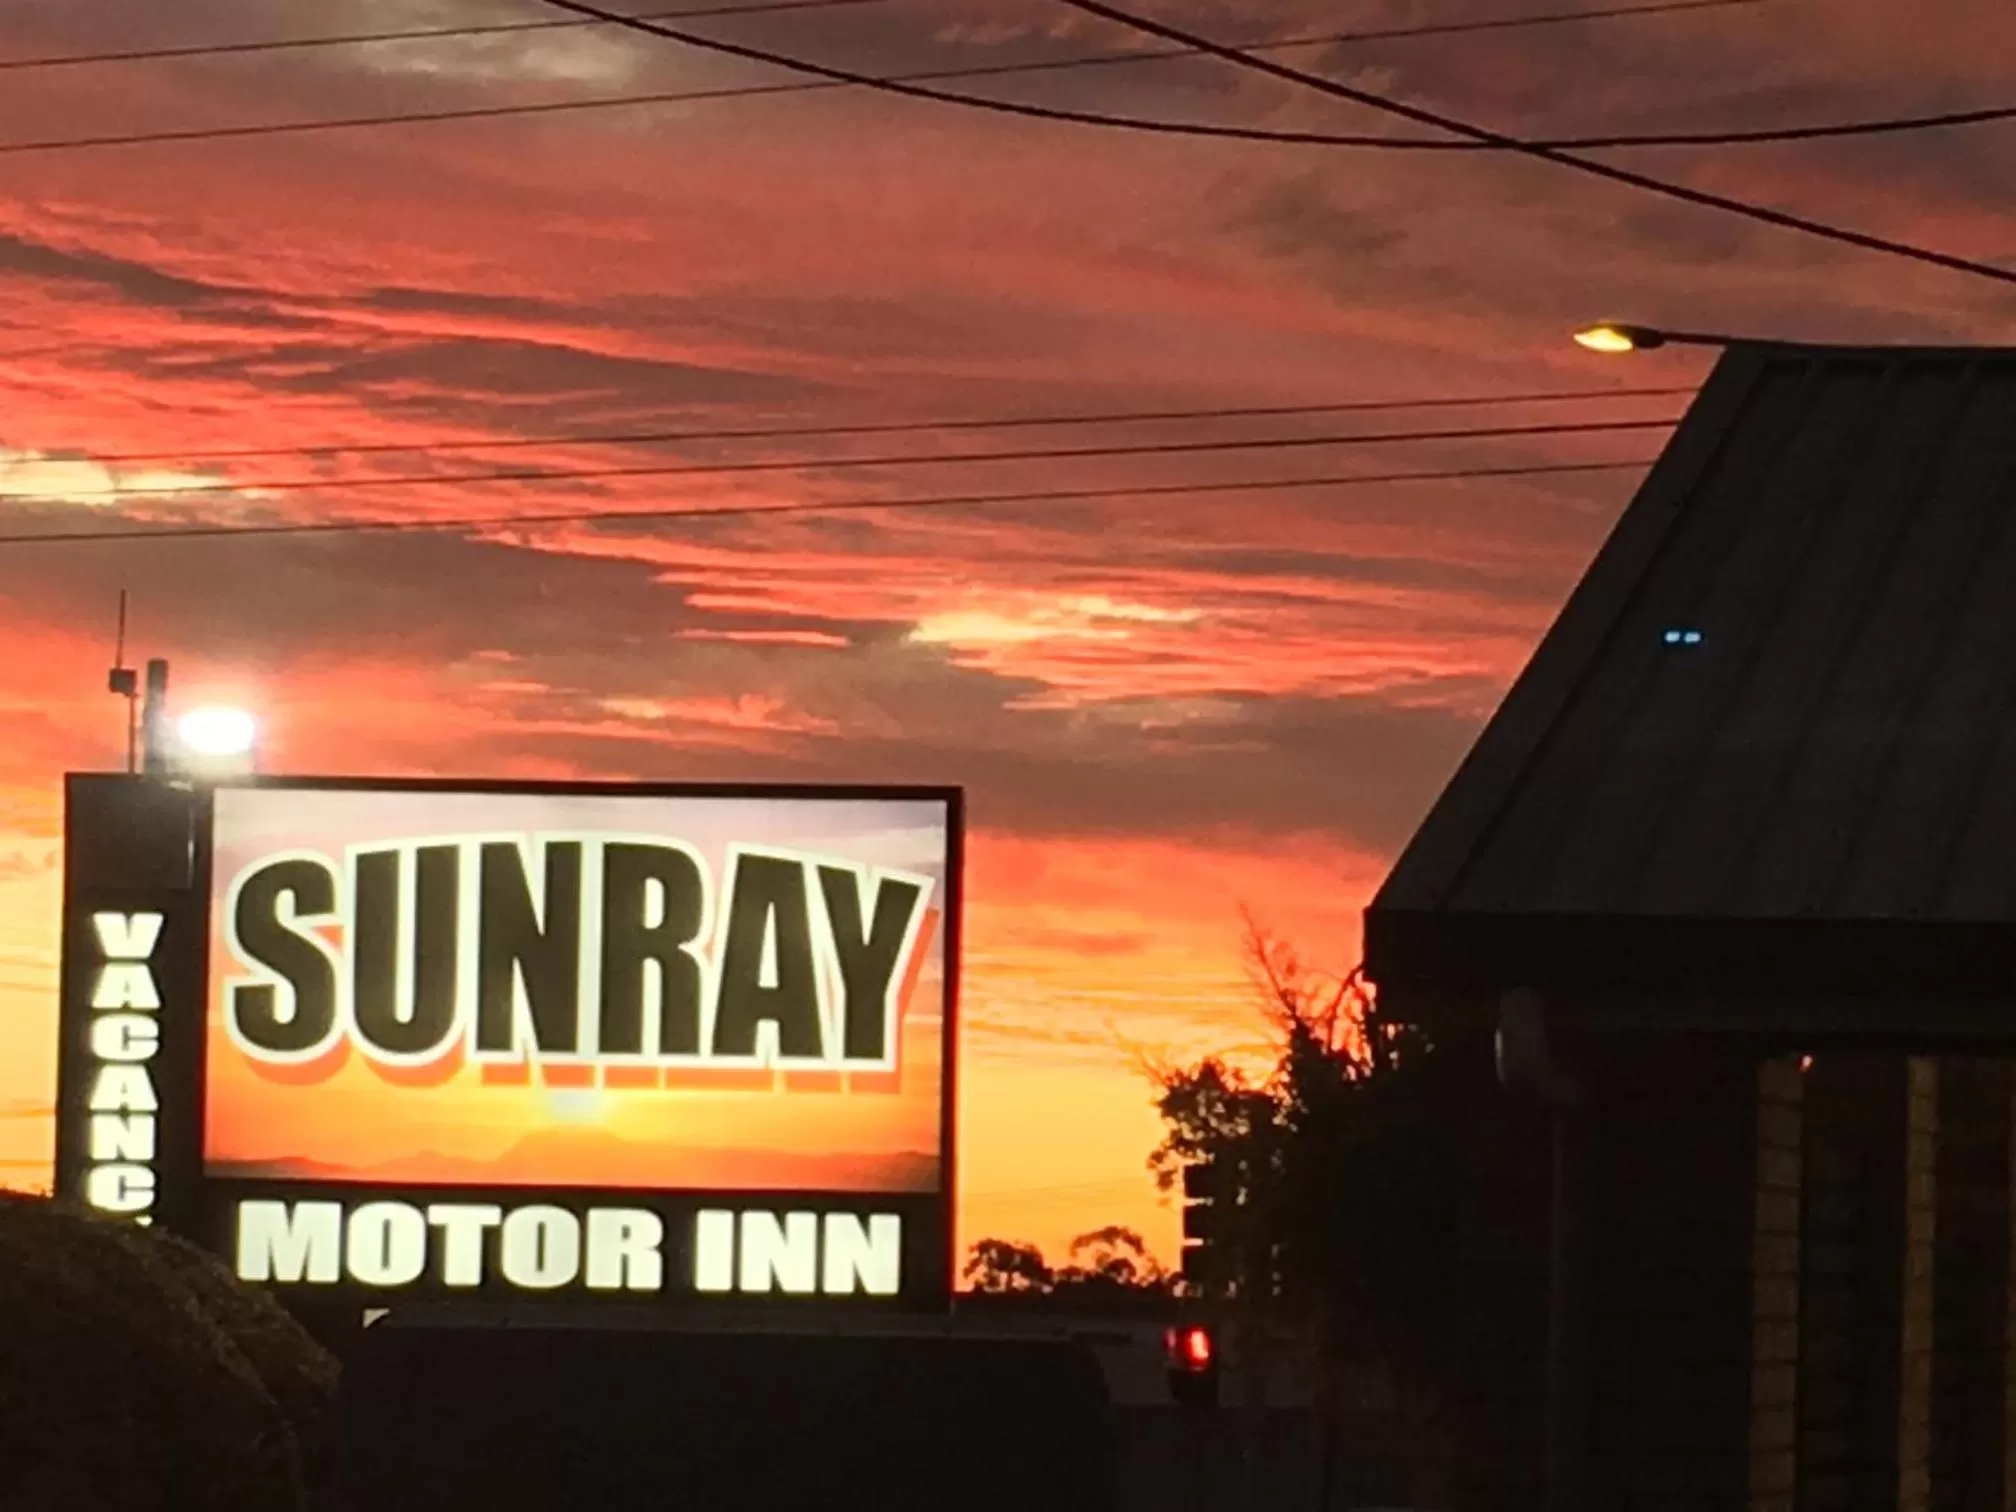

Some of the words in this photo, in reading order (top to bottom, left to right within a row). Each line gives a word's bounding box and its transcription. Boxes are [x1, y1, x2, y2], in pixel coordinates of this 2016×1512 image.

[88, 911, 164, 1227] VACANC
[227, 833, 933, 1070] SUNRAY
[237, 1200, 663, 1291] MOTOR
[695, 1209, 900, 1295] INN
